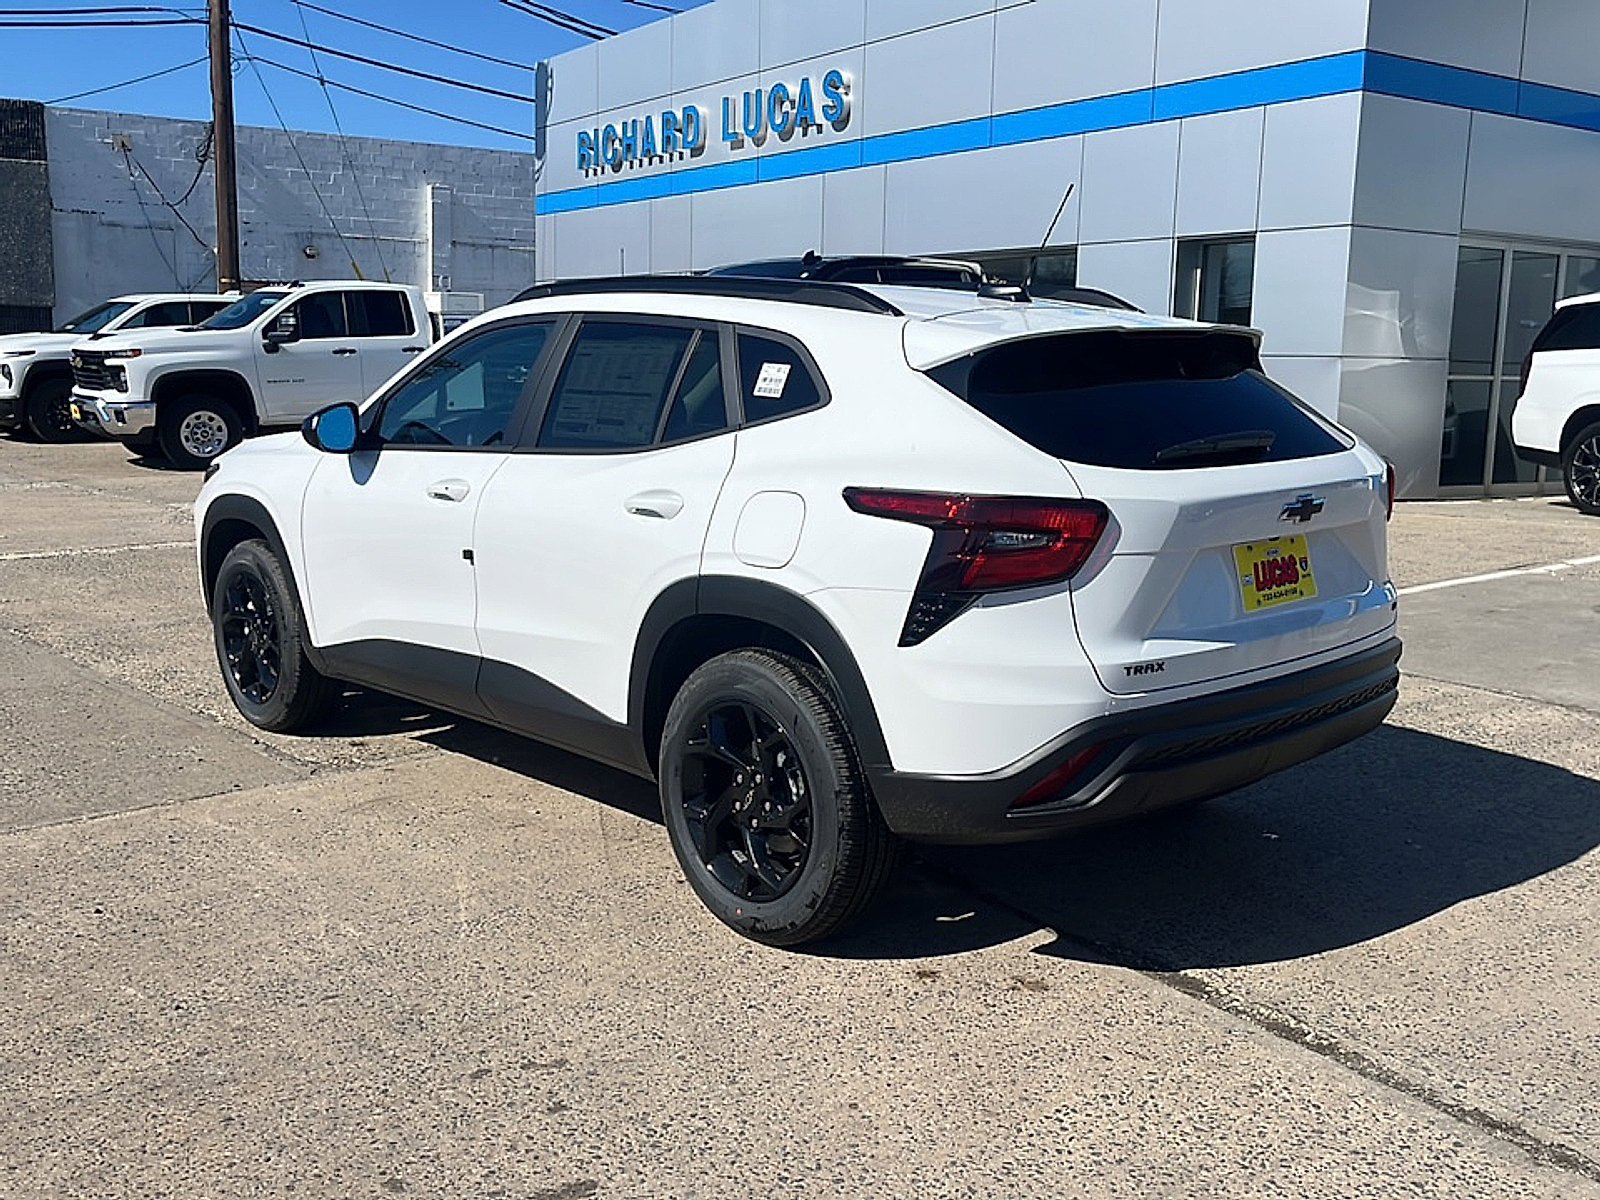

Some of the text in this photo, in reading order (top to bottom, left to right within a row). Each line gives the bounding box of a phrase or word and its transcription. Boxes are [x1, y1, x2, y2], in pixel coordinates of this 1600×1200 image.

[576, 69, 848, 171] RICHARD LUCAS
[1253, 554, 1300, 592] LUCAS
[1123, 661, 1165, 677] TRAX
